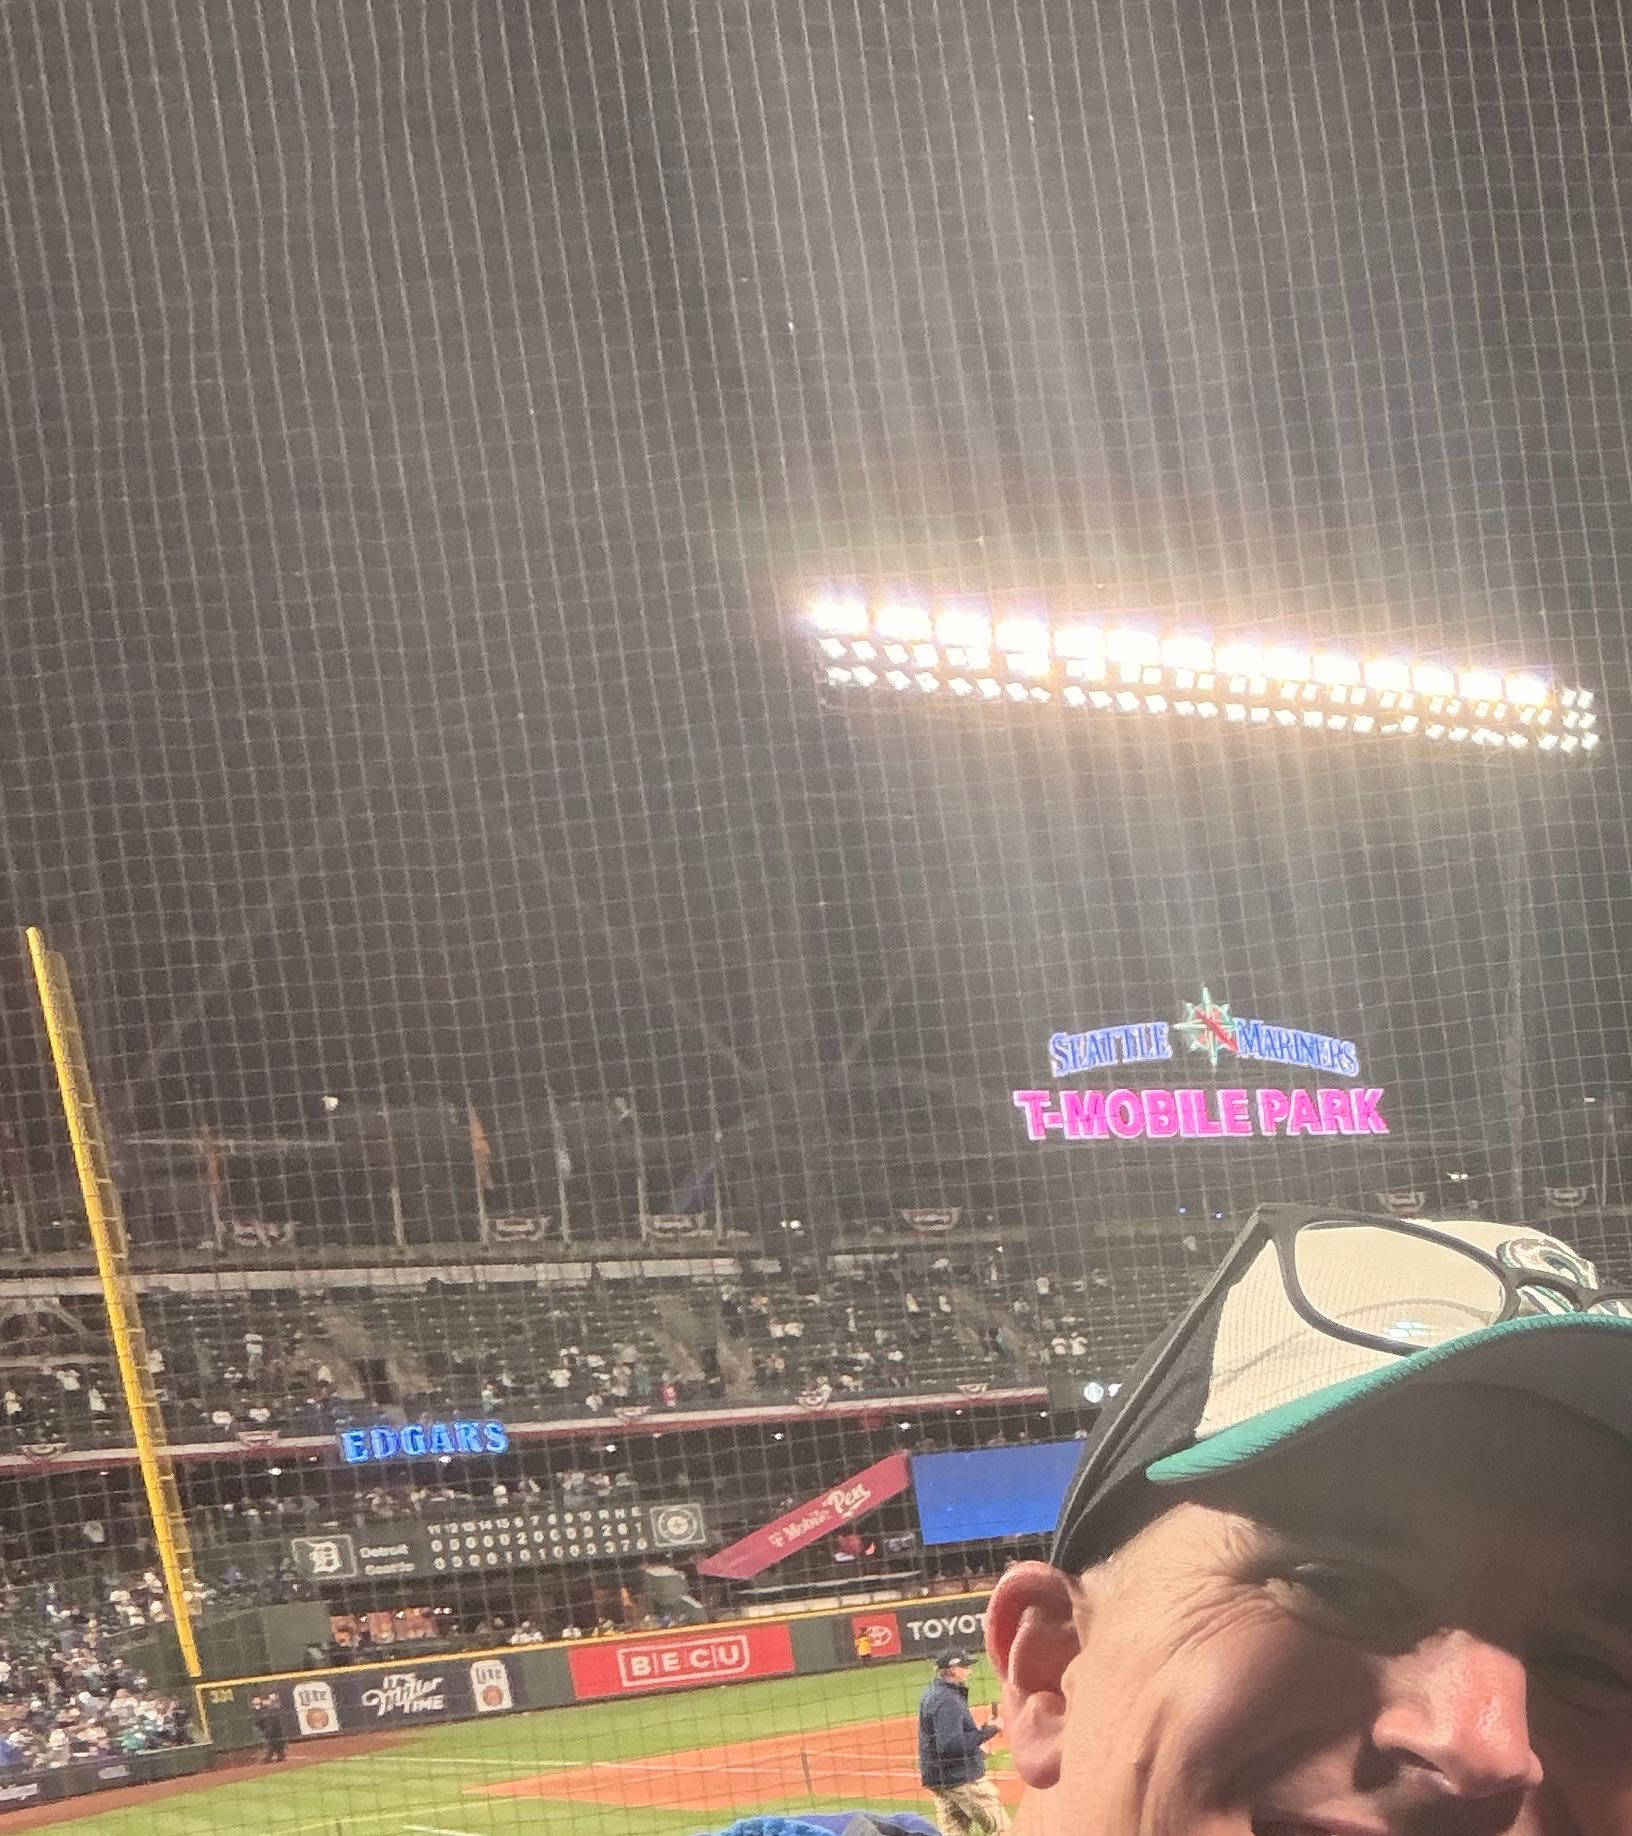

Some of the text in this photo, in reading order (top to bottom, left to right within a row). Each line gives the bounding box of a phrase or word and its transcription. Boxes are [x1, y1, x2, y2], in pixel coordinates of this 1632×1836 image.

[1048, 1017, 1361, 1078] SEATTLE MARINERS
[1013, 1088, 1391, 1141] T-MOBILE PARK
[822, 1483, 872, 1519] Pen
[516, 1531, 528, 1545] 2
[600, 1524, 612, 1537] 2
[475, 1667, 503, 1685] Lite
[361, 1676, 444, 1718] Miller
[402, 1694, 446, 1714] TIME
